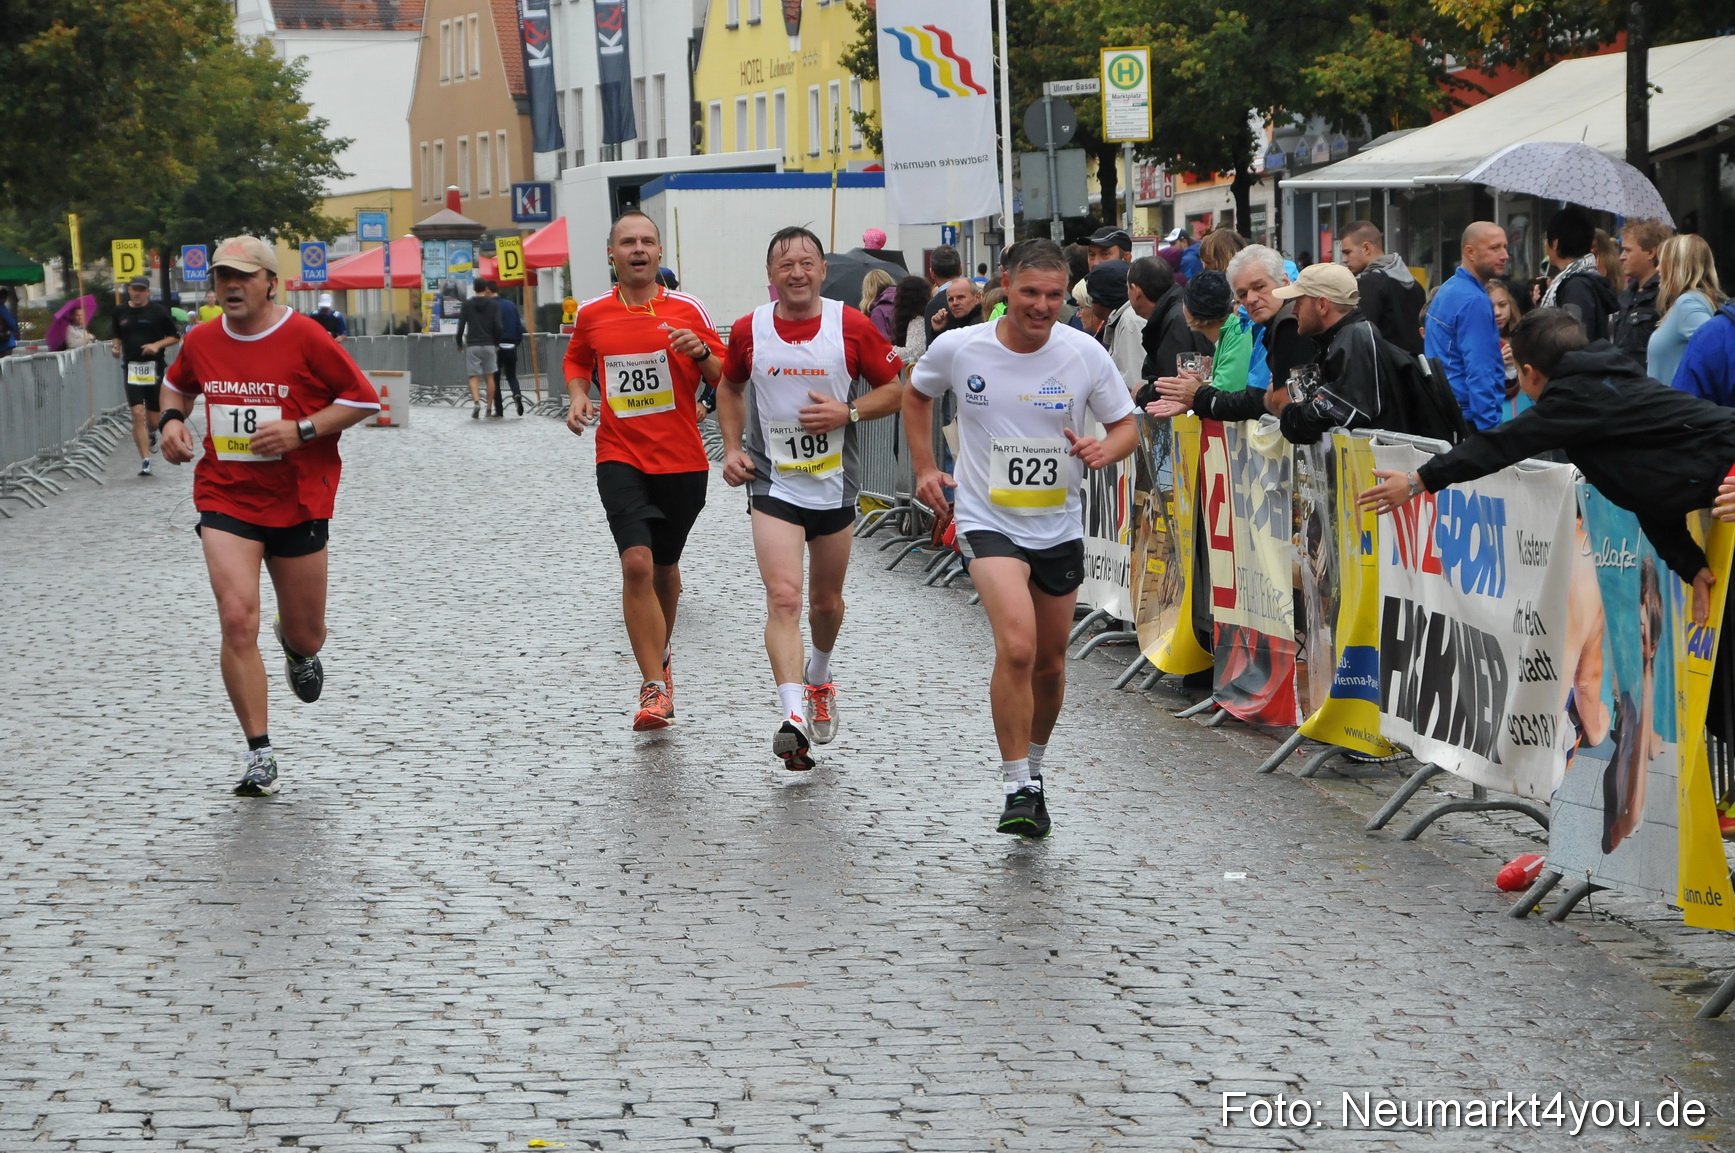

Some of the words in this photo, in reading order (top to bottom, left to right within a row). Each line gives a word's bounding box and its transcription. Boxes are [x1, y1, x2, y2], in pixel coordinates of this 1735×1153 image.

[740, 58, 764, 86] HOTEL
[1117, 62, 1135, 82] H
[1053, 84, 1074, 93] Ulmer
[1075, 81, 1097, 91] Gasse
[115, 240, 138, 250] Block
[498, 239, 521, 248] Block
[121, 252, 136, 273] D
[504, 250, 519, 270] D
[185, 269, 206, 279] TAXI
[303, 269, 325, 279] TAXI
[626, 358, 658, 367] Neumarkt
[783, 368, 829, 376] KLEBL
[618, 367, 660, 393] 285
[203, 380, 275, 396] NEUMARKT
[627, 397, 655, 408] Marko
[965, 392, 989, 402] PARTL
[229, 408, 257, 434] 18
[770, 426, 793, 435] PARTL
[785, 433, 829, 460] 198
[993, 444, 1021, 454] PARTL
[1022, 445, 1062, 454] Neumarkt
[1008, 457, 1059, 486] 623
